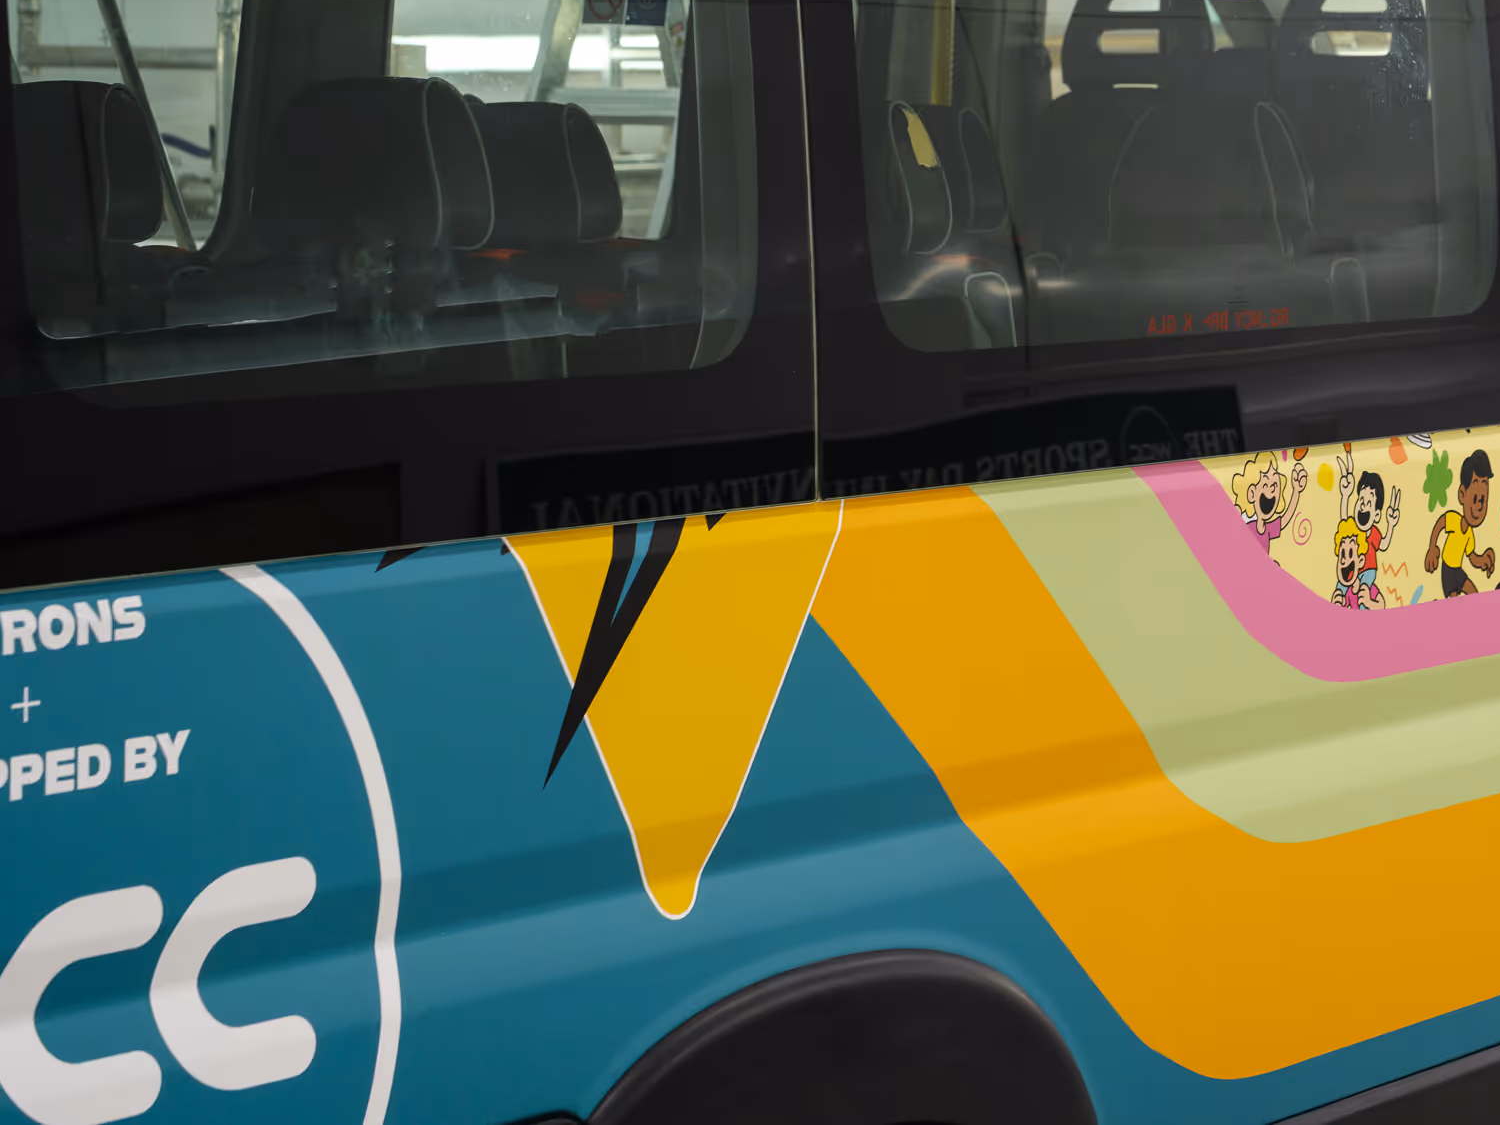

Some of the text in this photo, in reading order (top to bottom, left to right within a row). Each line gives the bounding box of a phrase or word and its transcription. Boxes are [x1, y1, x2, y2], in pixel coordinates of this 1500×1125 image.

[0, 595, 146, 656] RONS
[0, 729, 191, 802] PED BY
